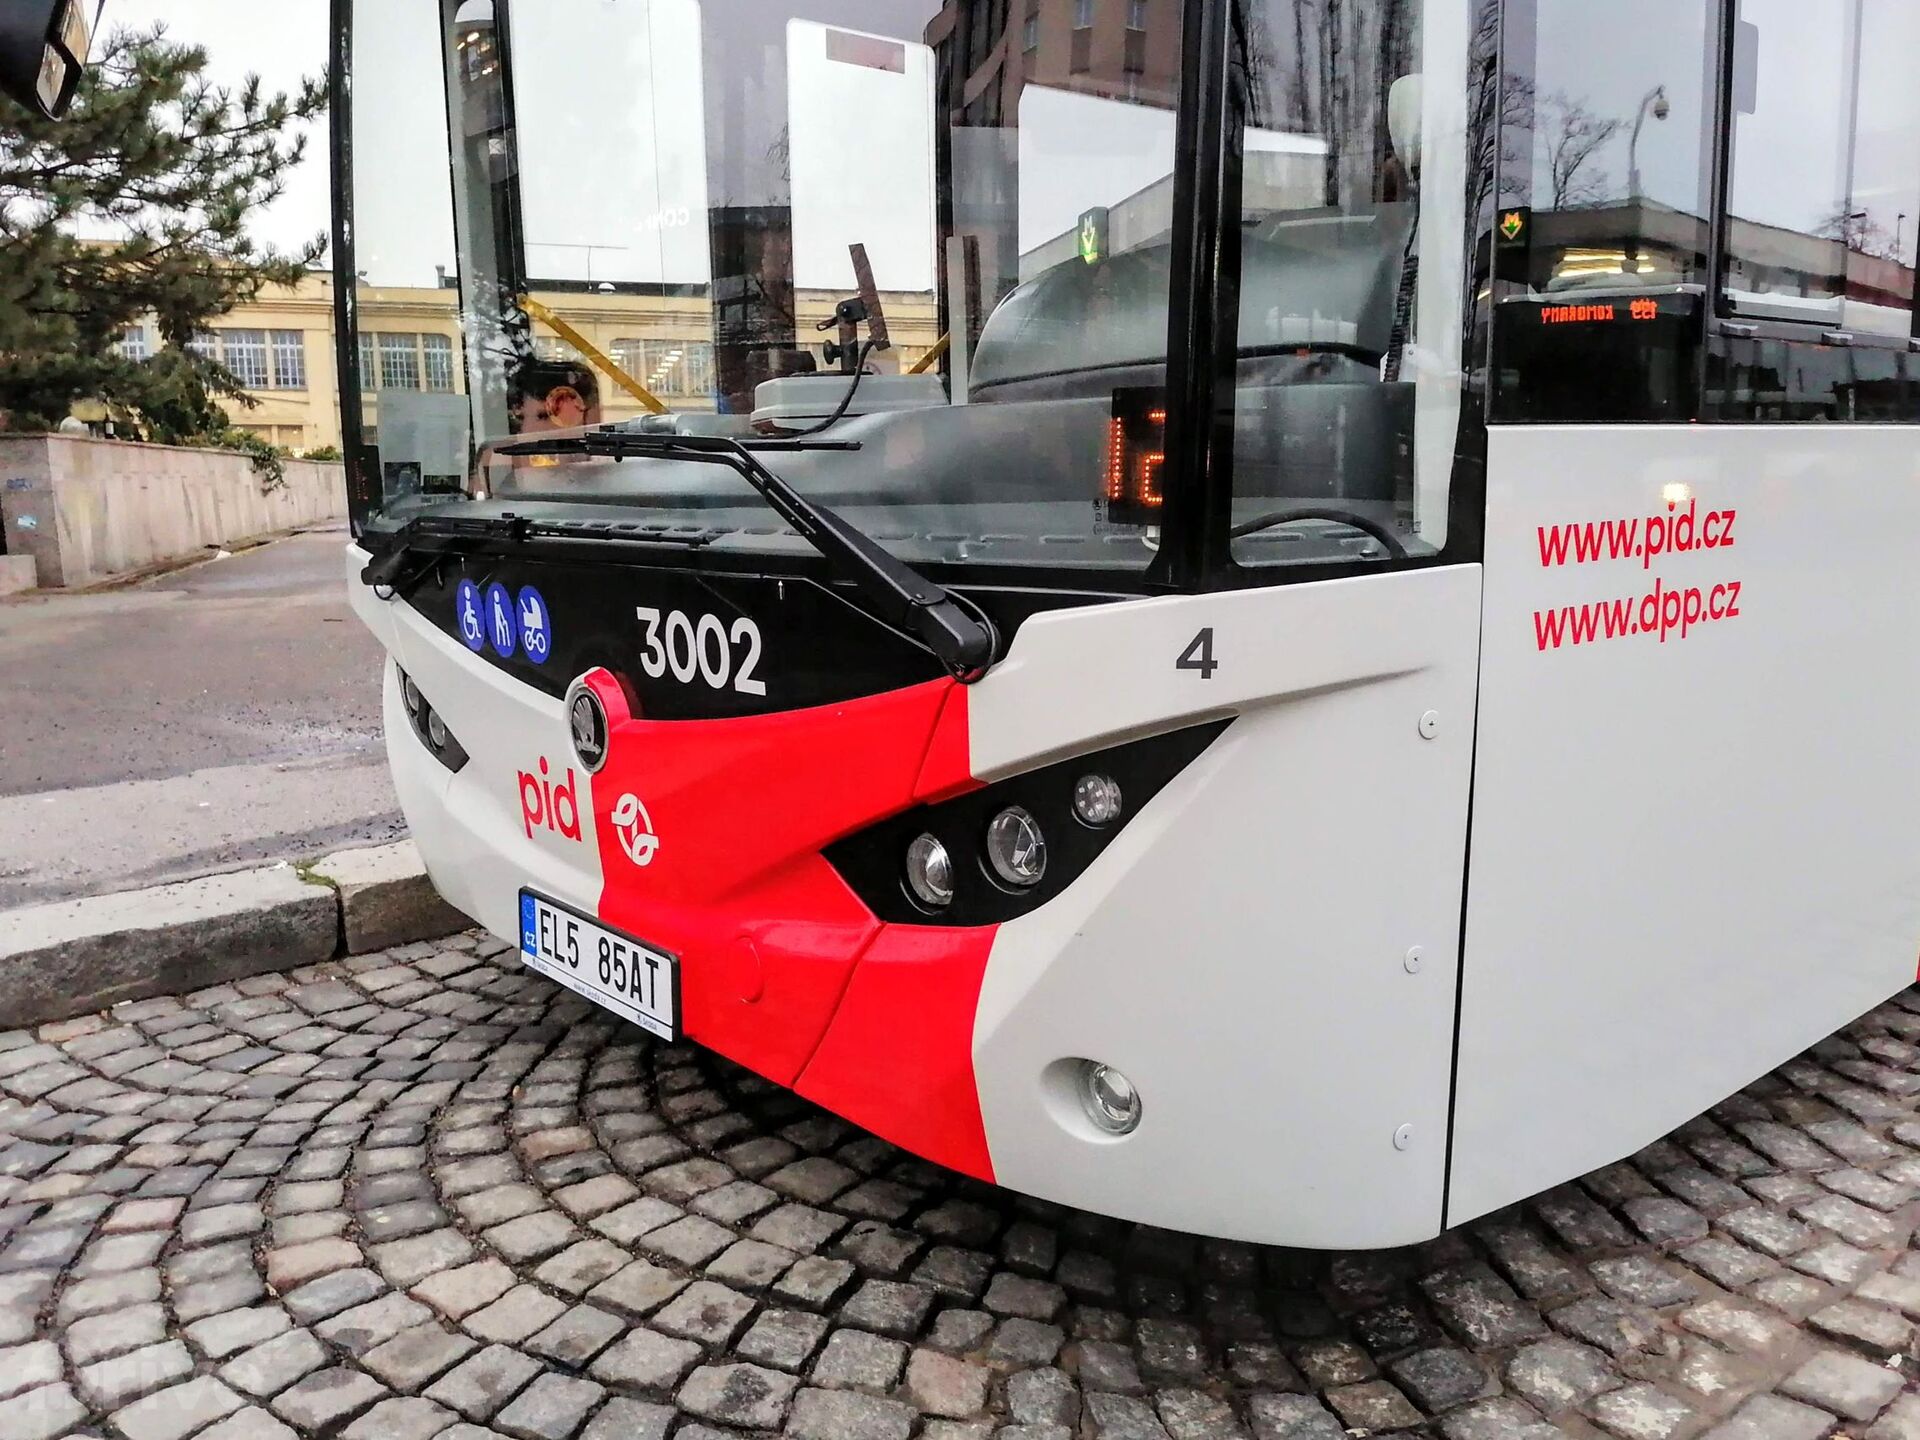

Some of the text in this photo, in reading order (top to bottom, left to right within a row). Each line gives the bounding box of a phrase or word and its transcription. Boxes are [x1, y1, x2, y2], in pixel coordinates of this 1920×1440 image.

[1537, 498, 1736, 569] www.pid.cz
[1534, 577, 1741, 651] www.dpp.cz
[636, 606, 767, 697] 3002
[1176, 627, 1218, 680] 4
[517, 756, 582, 841] pid
[525, 931, 536, 948] CZ
[540, 908, 660, 1010] EL5 85AT
